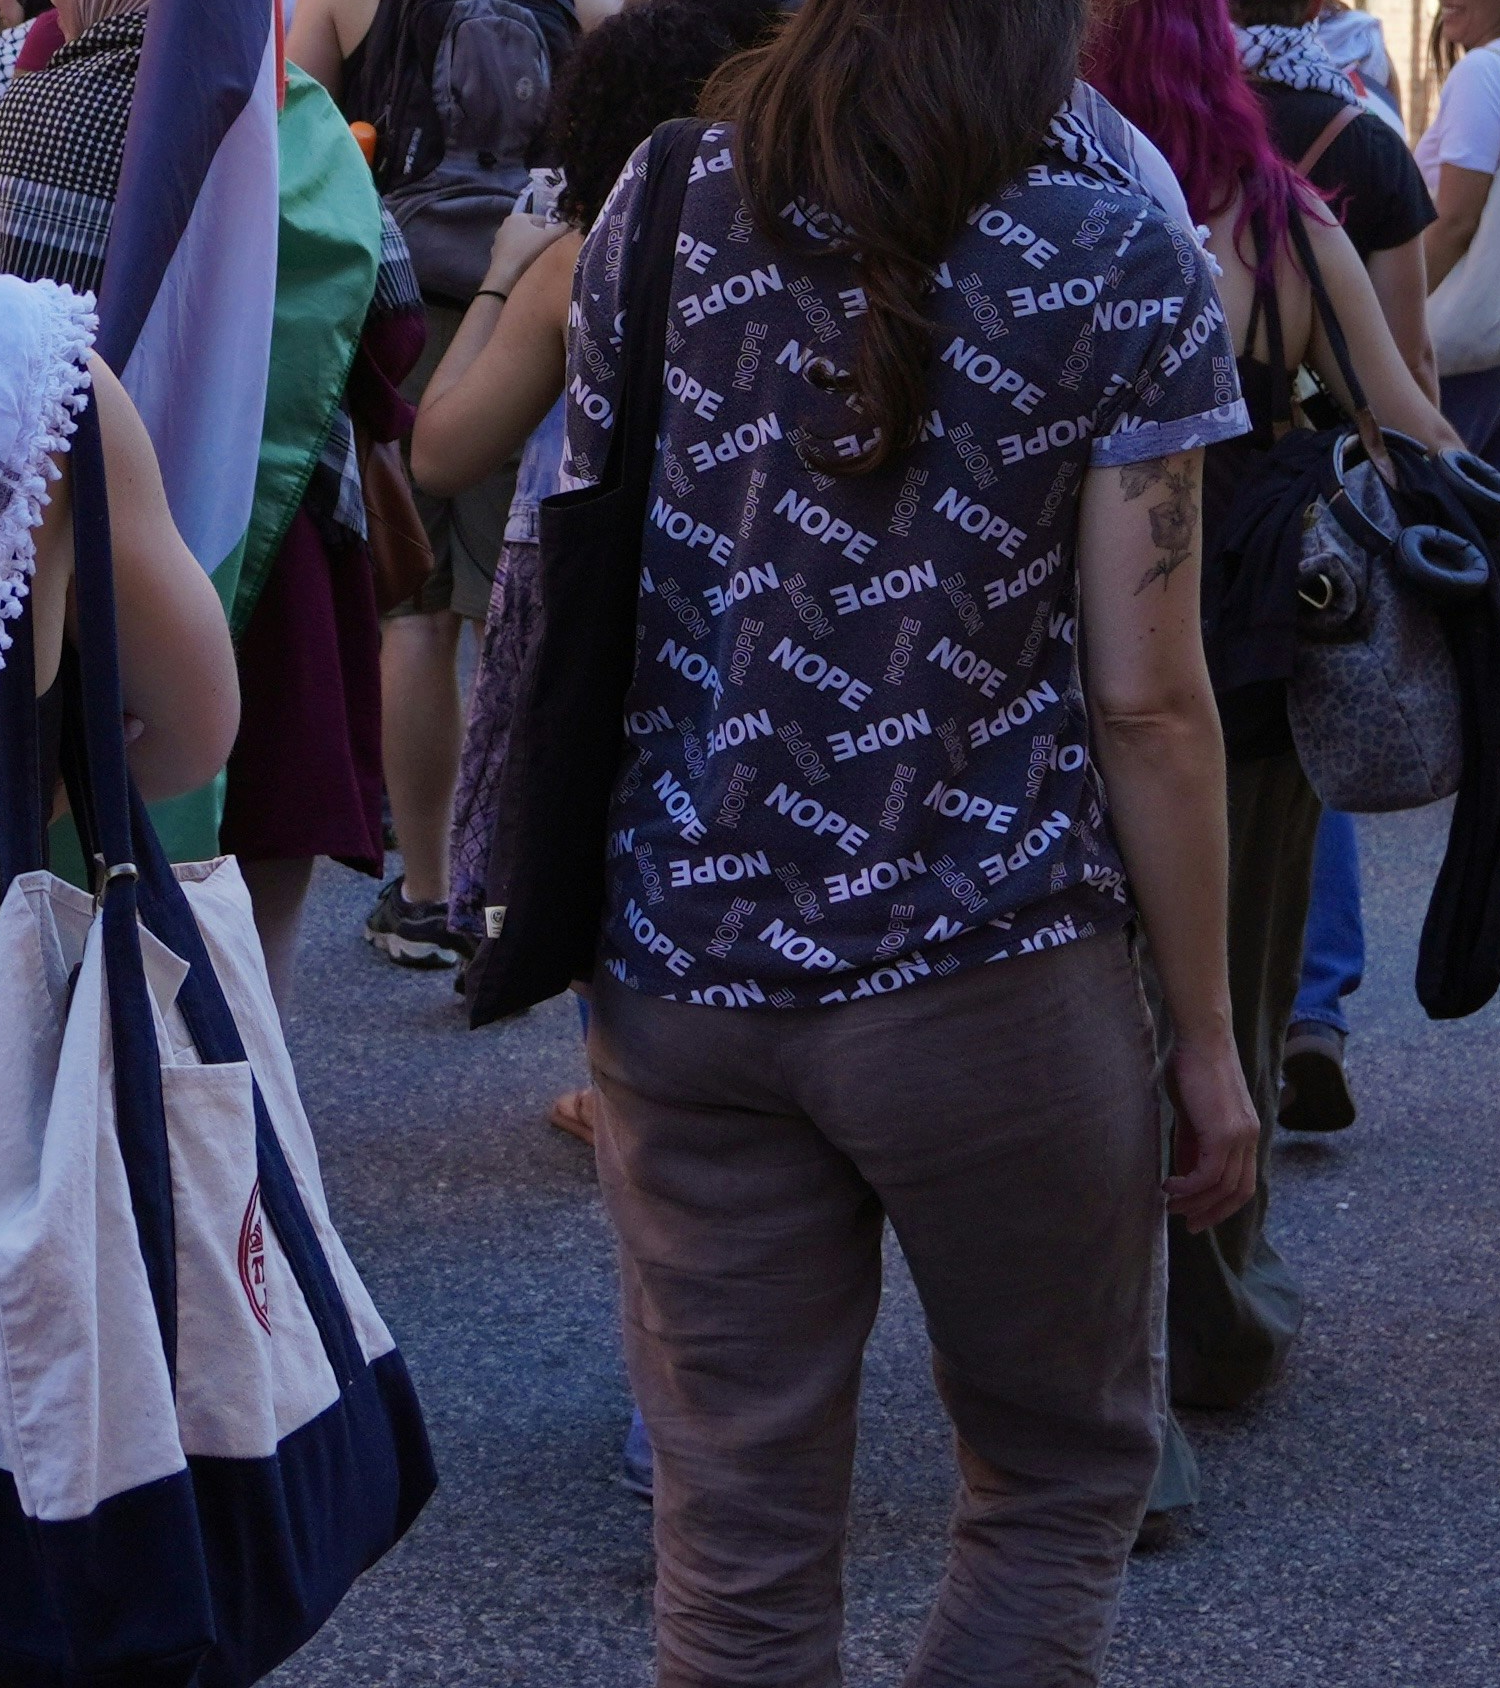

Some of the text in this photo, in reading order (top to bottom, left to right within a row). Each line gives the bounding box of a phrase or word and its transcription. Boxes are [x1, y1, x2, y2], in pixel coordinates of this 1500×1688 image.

[605, 213, 625, 282] NOPE
[1164, 221, 1196, 285] NOPE
[677, 264, 784, 327] NOPE
[787, 276, 841, 343] NOPE
[956, 273, 1009, 341] NOPE
[1093, 296, 1185, 333] NOPE
[732, 321, 768, 390] NOPE
[1160, 298, 1225, 377] NOPE
[940, 336, 1046, 415] NOPE
[687, 412, 783, 473] NOPE
[948, 422, 998, 490] NOPE
[650, 496, 735, 567] NOPE
[739, 469, 767, 539] NOPE
[773, 488, 878, 565] NOPE
[888, 467, 929, 537] NOPE
[933, 486, 1027, 560] NOPE
[658, 577, 711, 640] NOPE
[703, 562, 781, 616] NOPE
[783, 573, 835, 640] NOPE
[830, 560, 939, 616] NOPE
[941, 572, 984, 637] NOPE
[983, 543, 1062, 610] NOPE
[656, 638, 725, 712] NOPE
[728, 618, 764, 686] NOPE
[768, 636, 873, 712] NOPE
[883, 616, 922, 686] NOPE
[926, 636, 1008, 700] NOPE
[706, 708, 775, 759] NOPE
[826, 708, 932, 763] NOPE
[967, 680, 1060, 750] NOPE
[777, 720, 831, 787] NOPE
[1025, 734, 1055, 799] NOPE
[652, 769, 708, 846] NOPE
[716, 762, 758, 829] NOPE
[764, 781, 870, 857] NOPE
[879, 763, 917, 832] NOPE
[922, 780, 1018, 834] NOPE
[634, 841, 665, 906] NOPE
[669, 850, 772, 888] NOPE
[823, 851, 928, 904] NOPE
[979, 809, 1072, 886] NOPE
[775, 861, 825, 926] NOPE
[930, 854, 989, 914] NOPE
[623, 897, 697, 978] NOPE
[705, 896, 757, 959] NOPE
